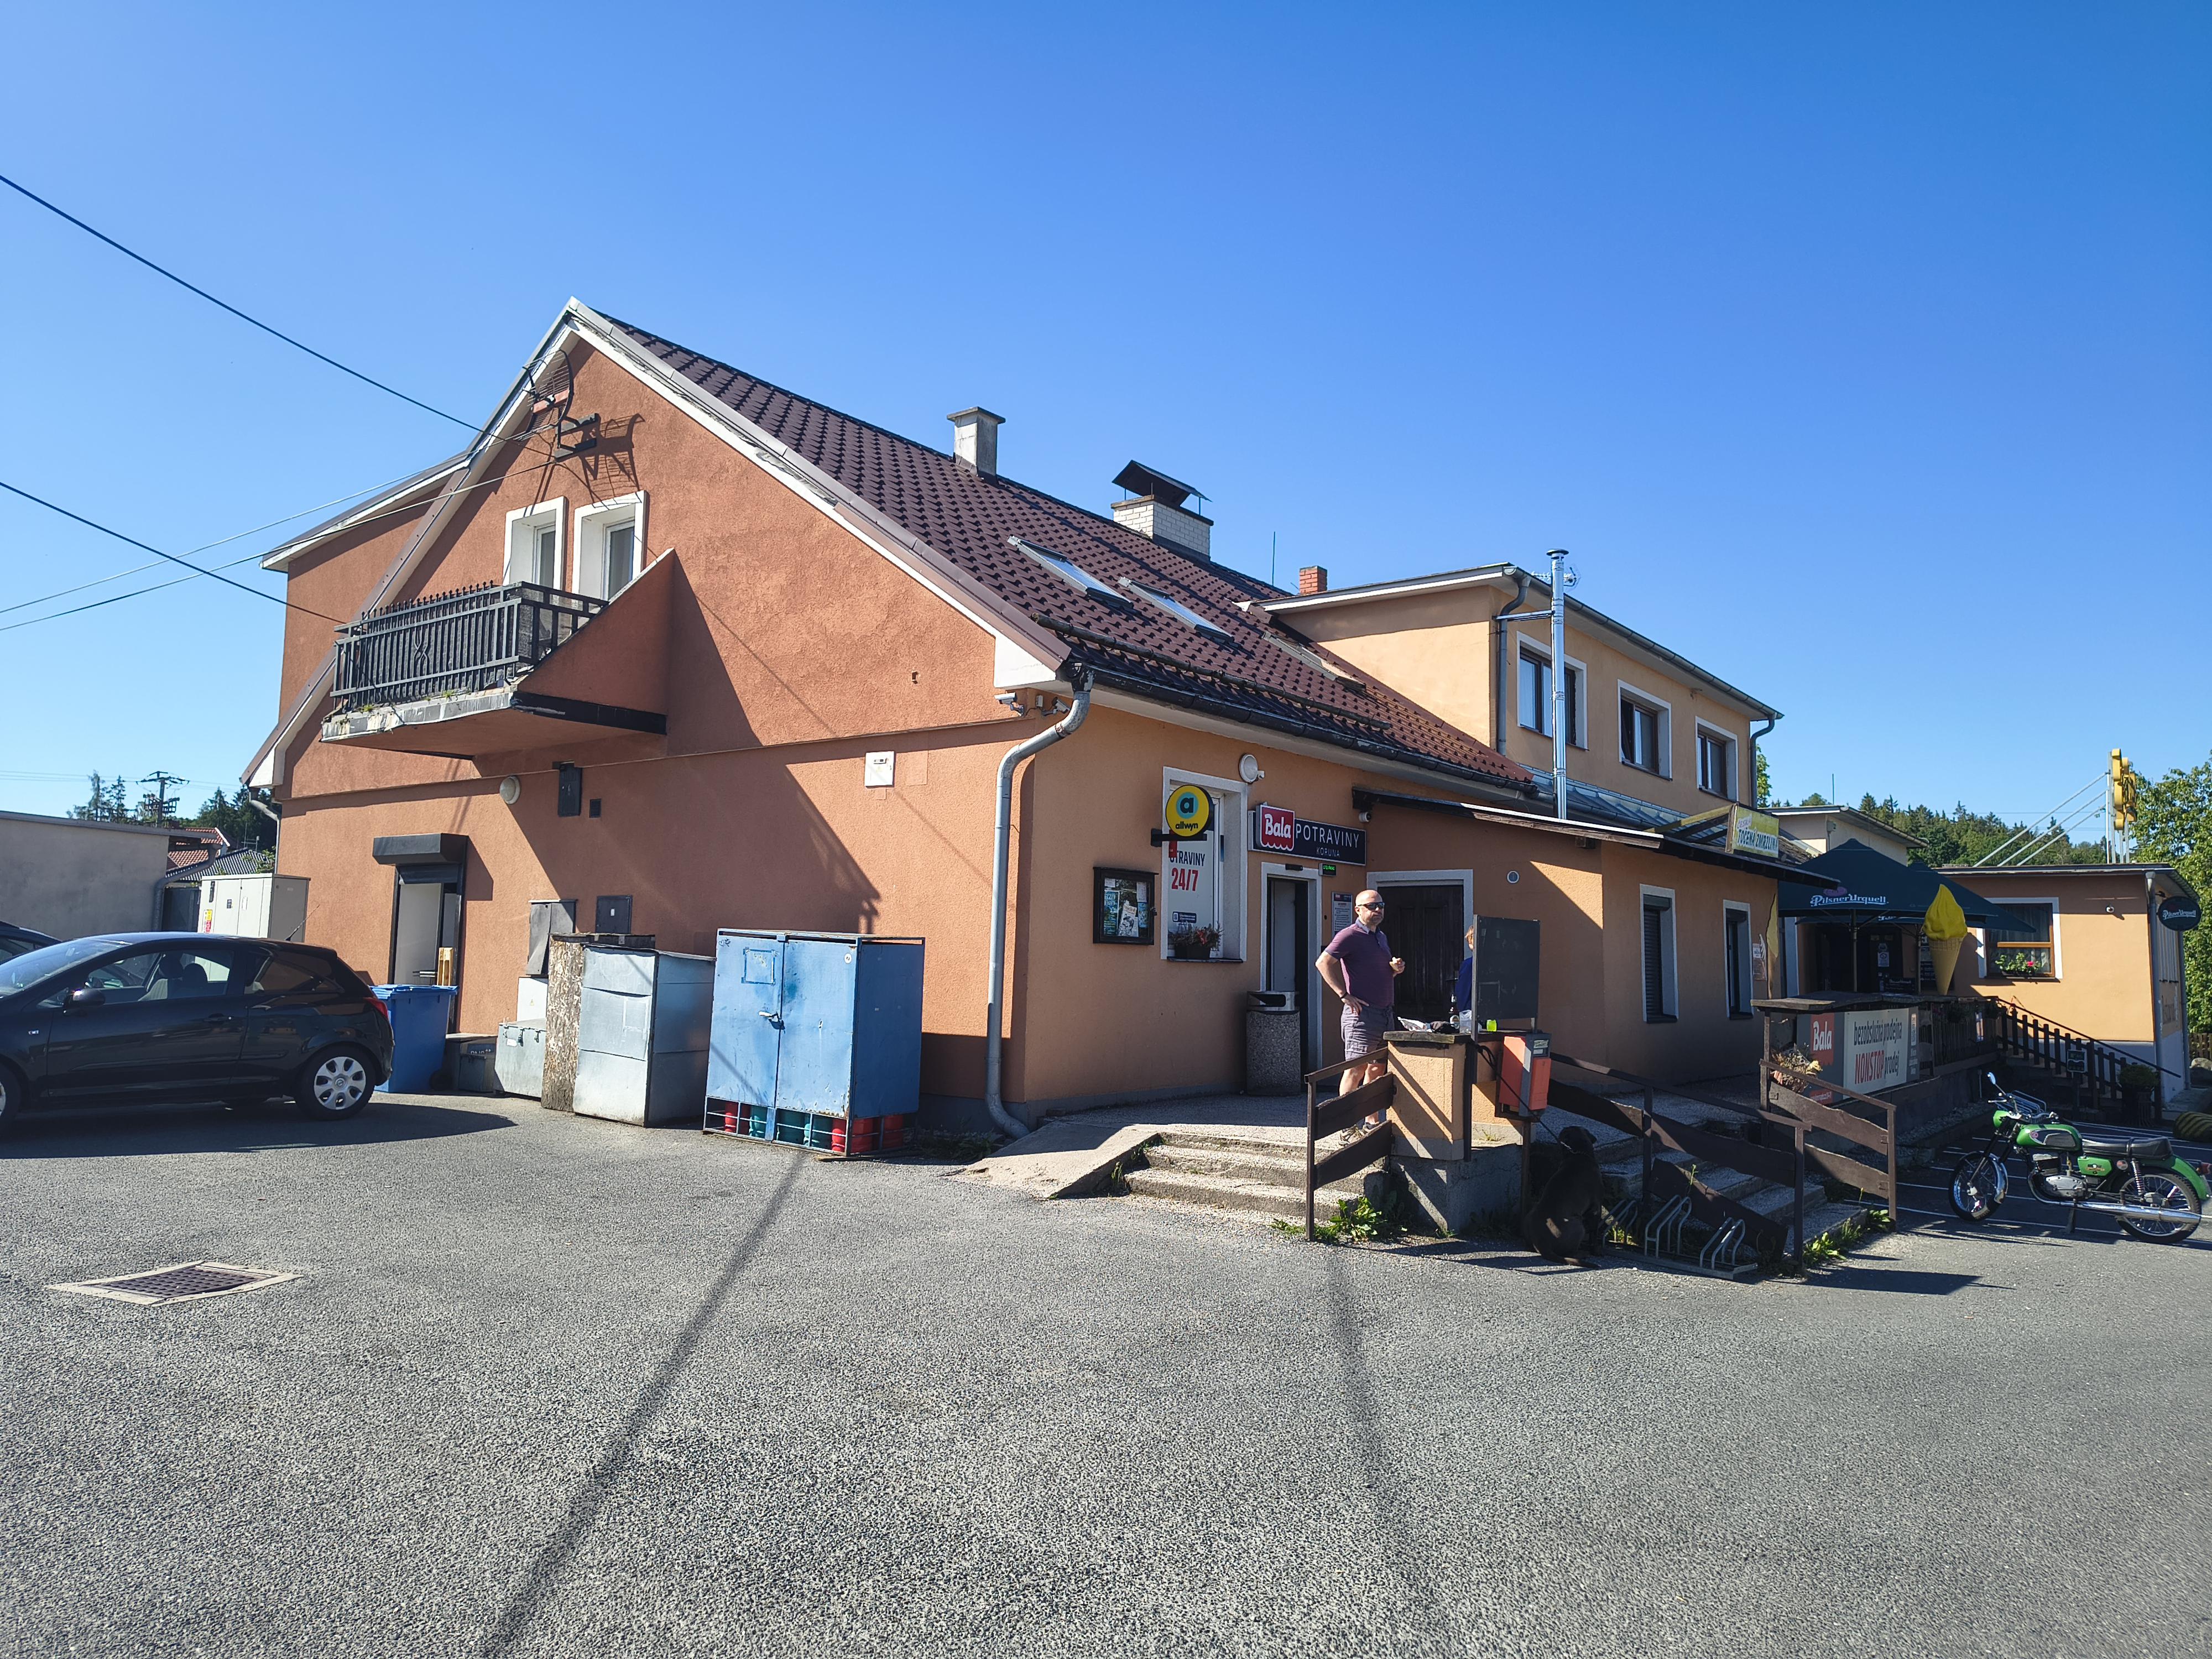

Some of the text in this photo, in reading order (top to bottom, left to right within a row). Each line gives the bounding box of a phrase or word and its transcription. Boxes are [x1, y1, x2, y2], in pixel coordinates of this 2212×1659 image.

[1180, 797, 1194, 813] a
[1175, 821, 1198, 832] allwyn
[1264, 813, 1291, 839] Bala
[1296, 823, 1359, 848] POTRAVINY
[1170, 850, 1205, 867] TRAVINY
[1316, 847, 1340, 858] KORUNA
[1171, 867, 1198, 891] 24/7
[1810, 894, 1886, 907] Pilsner Urquell
[2162, 909, 2197, 920] Pilsner Urquell
[1813, 1021, 1832, 1051] Bala
[1883, 1018, 1902, 1046] prodejna
[1855, 1050, 1884, 1084] NONSTOP
[1884, 1050, 1900, 1079] prodej
